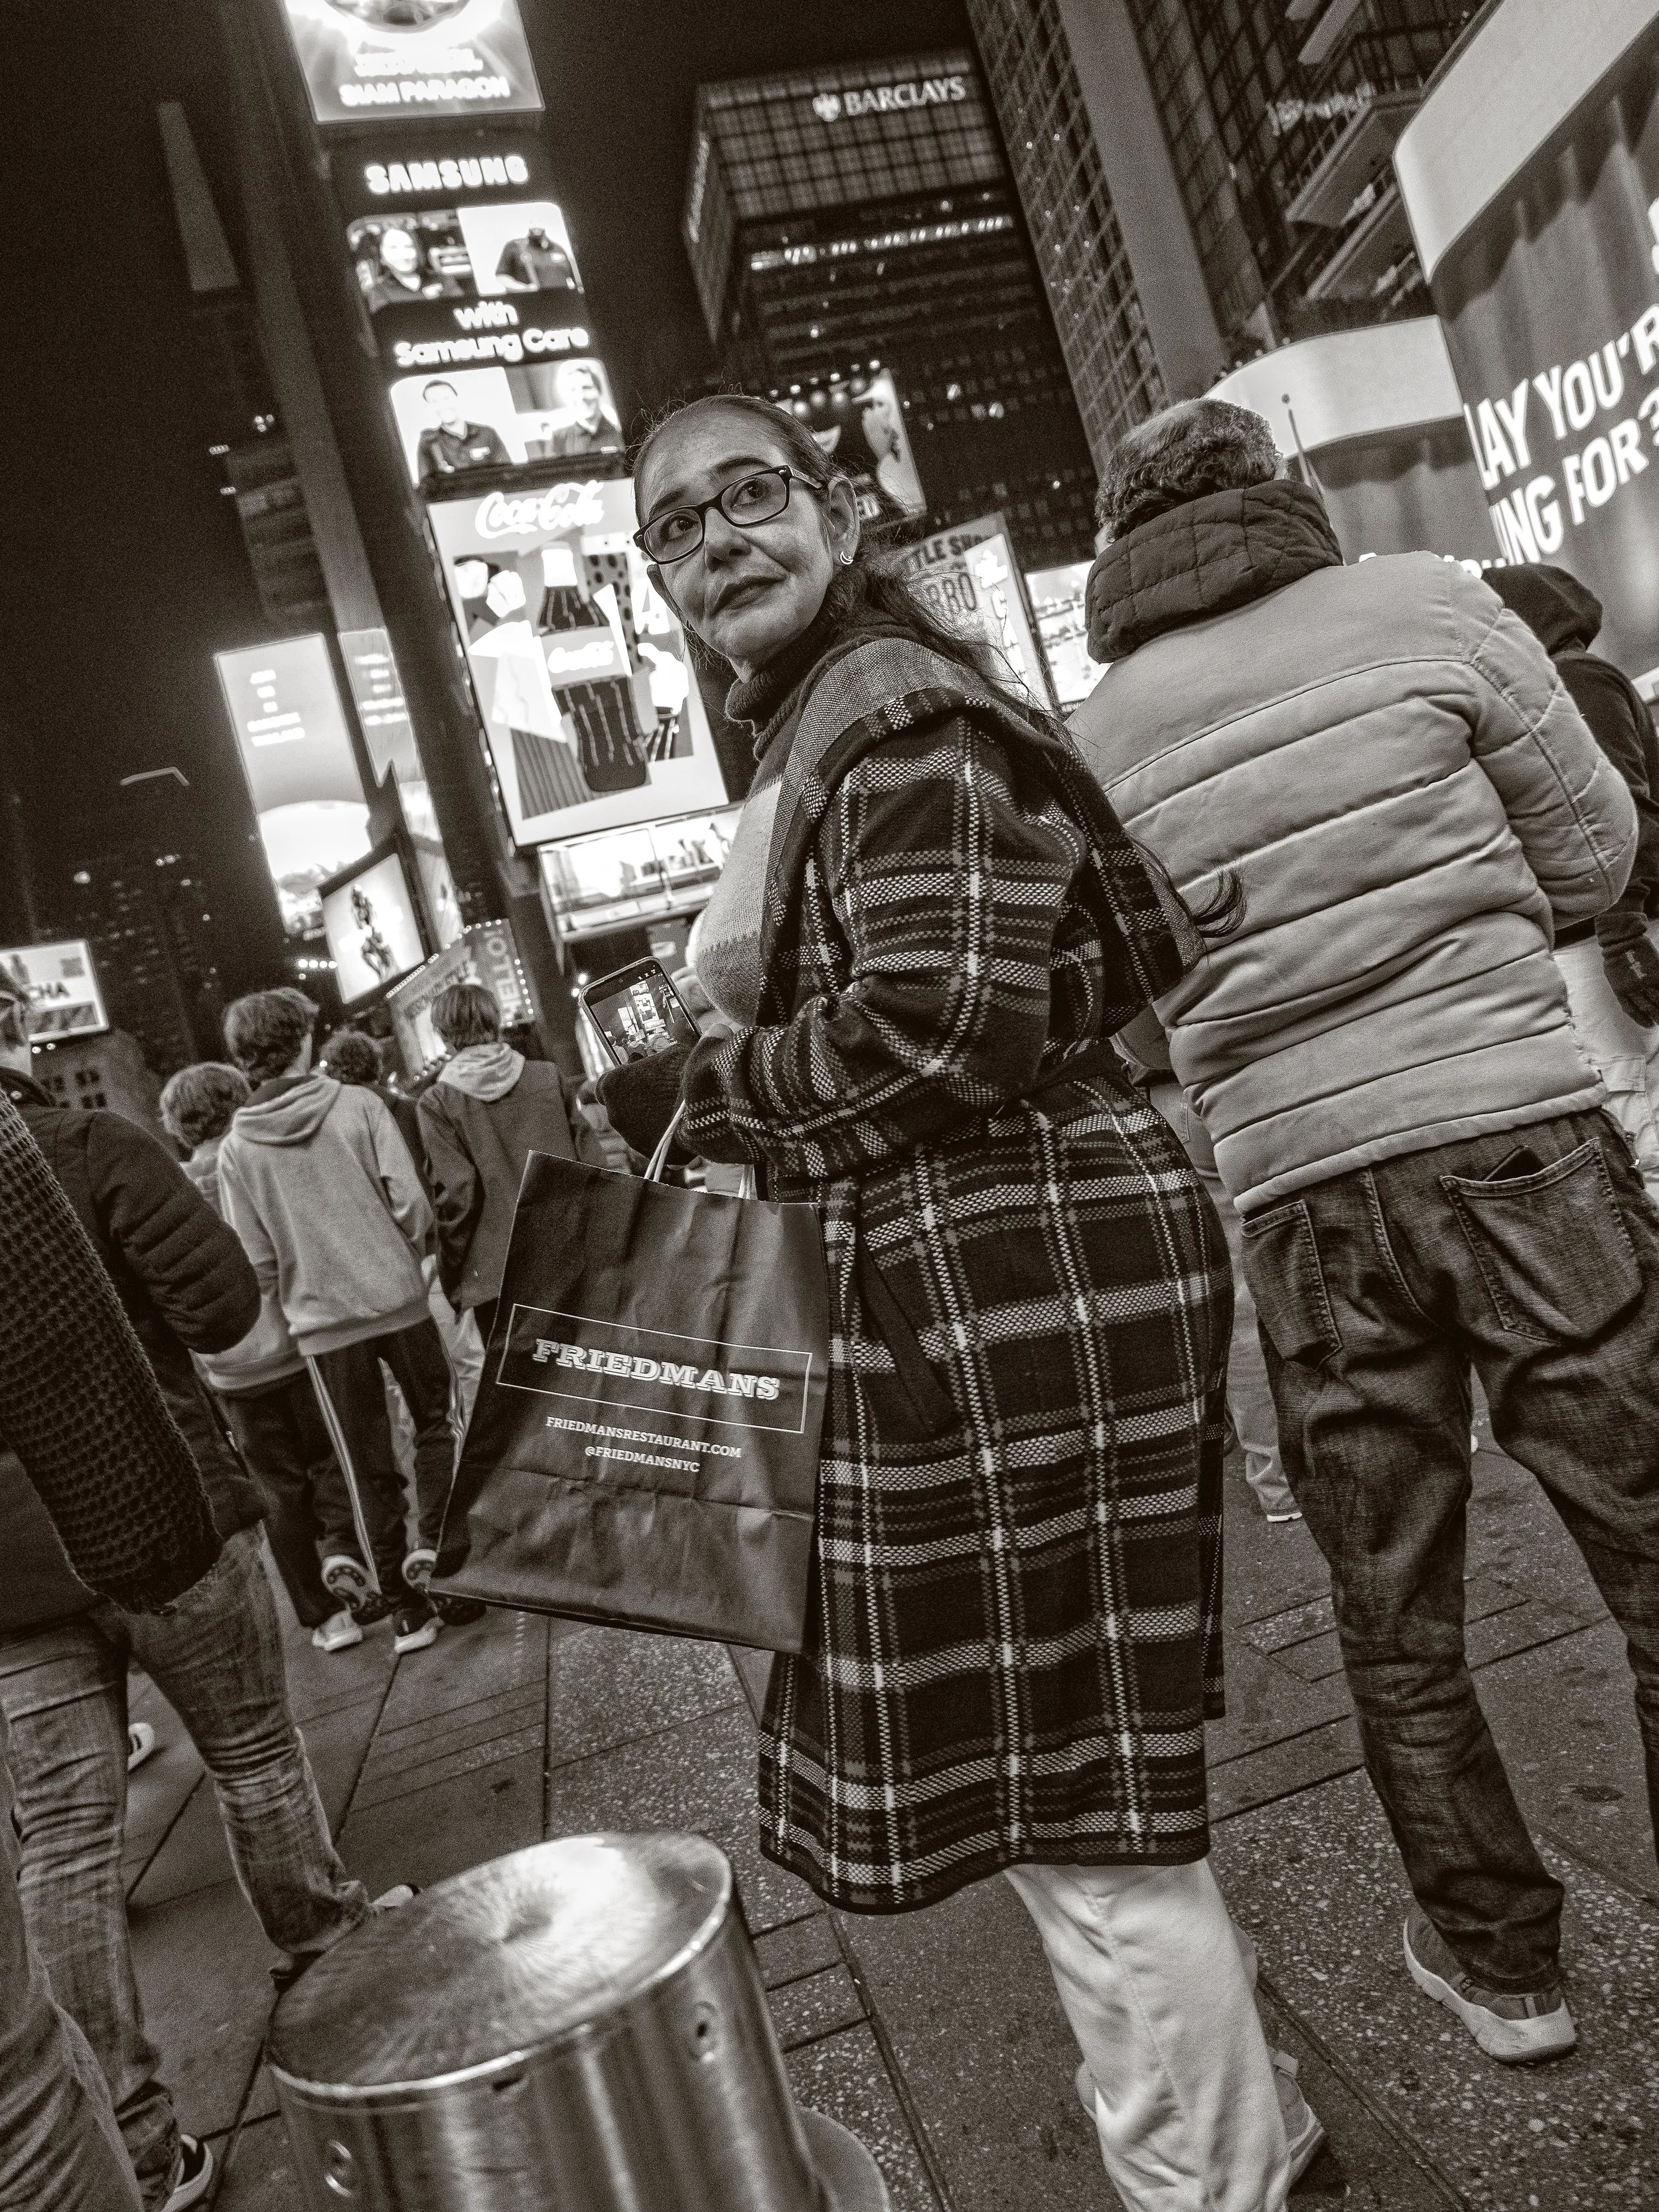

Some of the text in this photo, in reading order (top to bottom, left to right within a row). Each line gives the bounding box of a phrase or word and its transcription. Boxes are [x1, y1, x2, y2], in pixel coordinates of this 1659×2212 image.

[843, 76, 966, 115] BARCLAYS
[366, 155, 528, 194] SAMSUNG
[453, 301, 519, 329] with
[532, 1338, 780, 1400] FRIEDMANS
[545, 1416, 743, 1458] FRIEDMANSRESTAURANT.COM
[584, 1445, 701, 1473] @FRIEDMANSNYC
